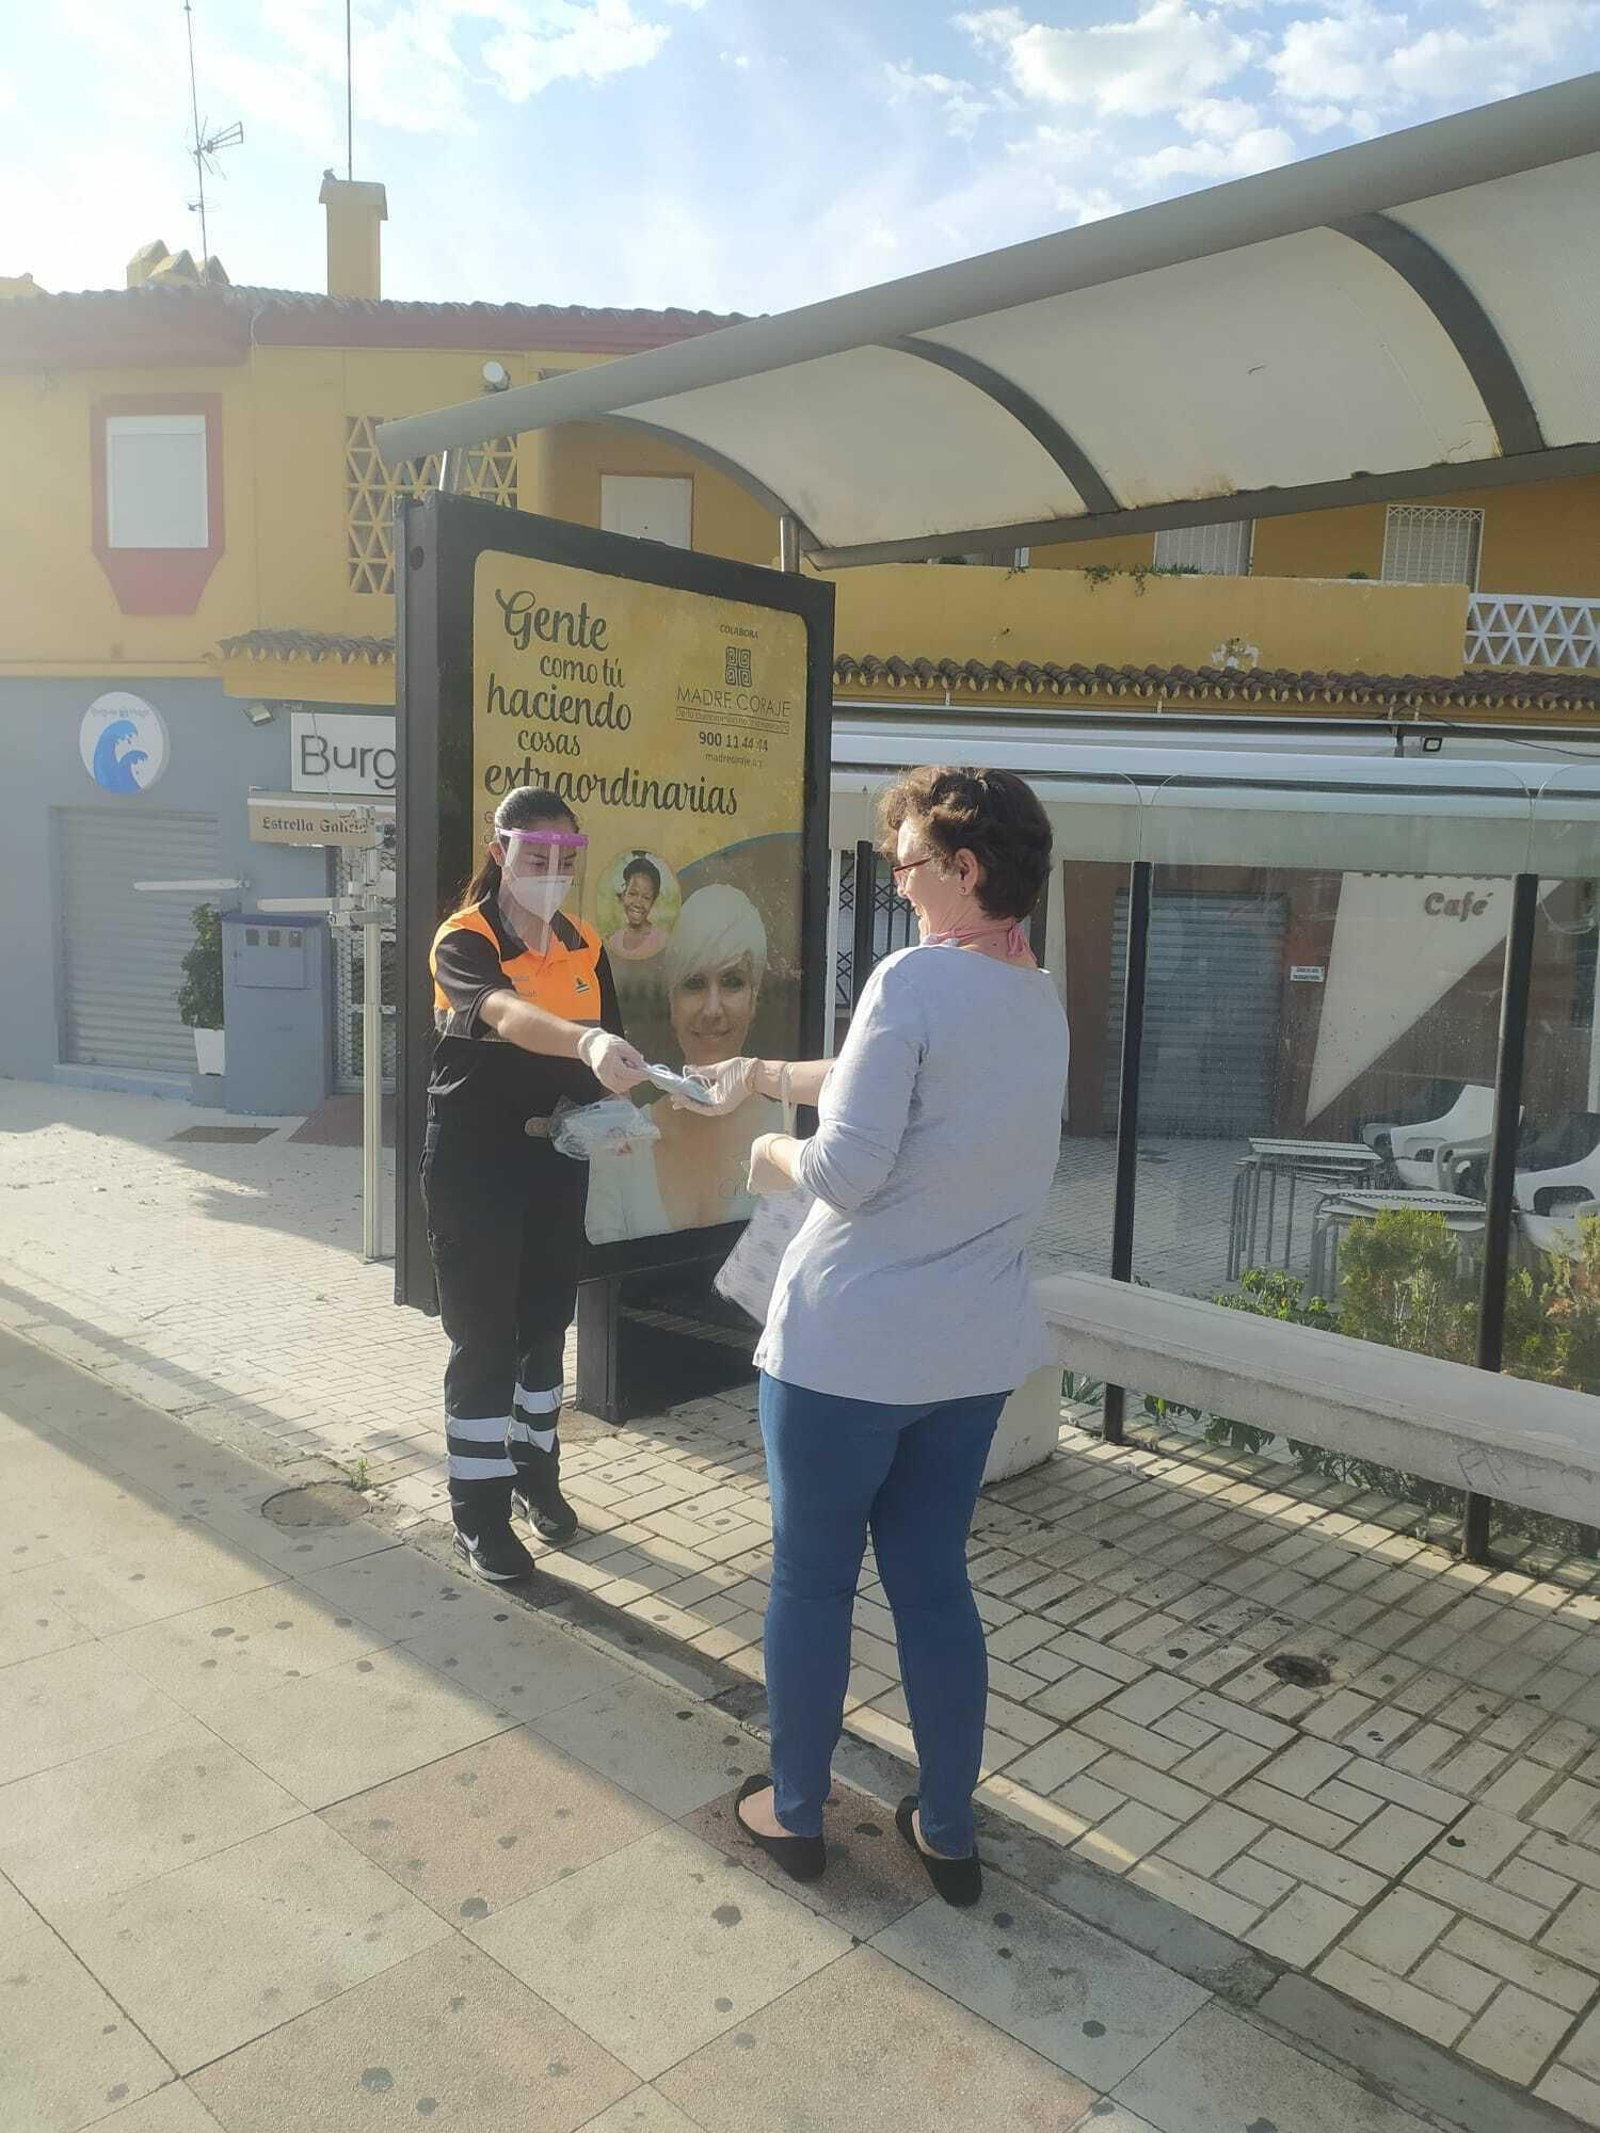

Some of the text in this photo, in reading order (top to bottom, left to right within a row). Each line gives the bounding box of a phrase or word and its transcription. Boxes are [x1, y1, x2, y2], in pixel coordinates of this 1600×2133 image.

[495, 588, 610, 651] Gente
[720, 624, 759, 639] COLABORA
[540, 655, 625, 688] como tú
[486, 672, 631, 731] haciendo
[676, 685, 792, 718] MADRE CORAJE
[517, 729, 581, 756] cosas
[699, 731, 722, 747] 900
[726, 734, 739, 749] 11
[301, 734, 396, 790] Burg
[484, 756, 738, 815] extraordinarias
[262, 816, 314, 833] Estrella
[1424, 891, 1494, 922] Café
